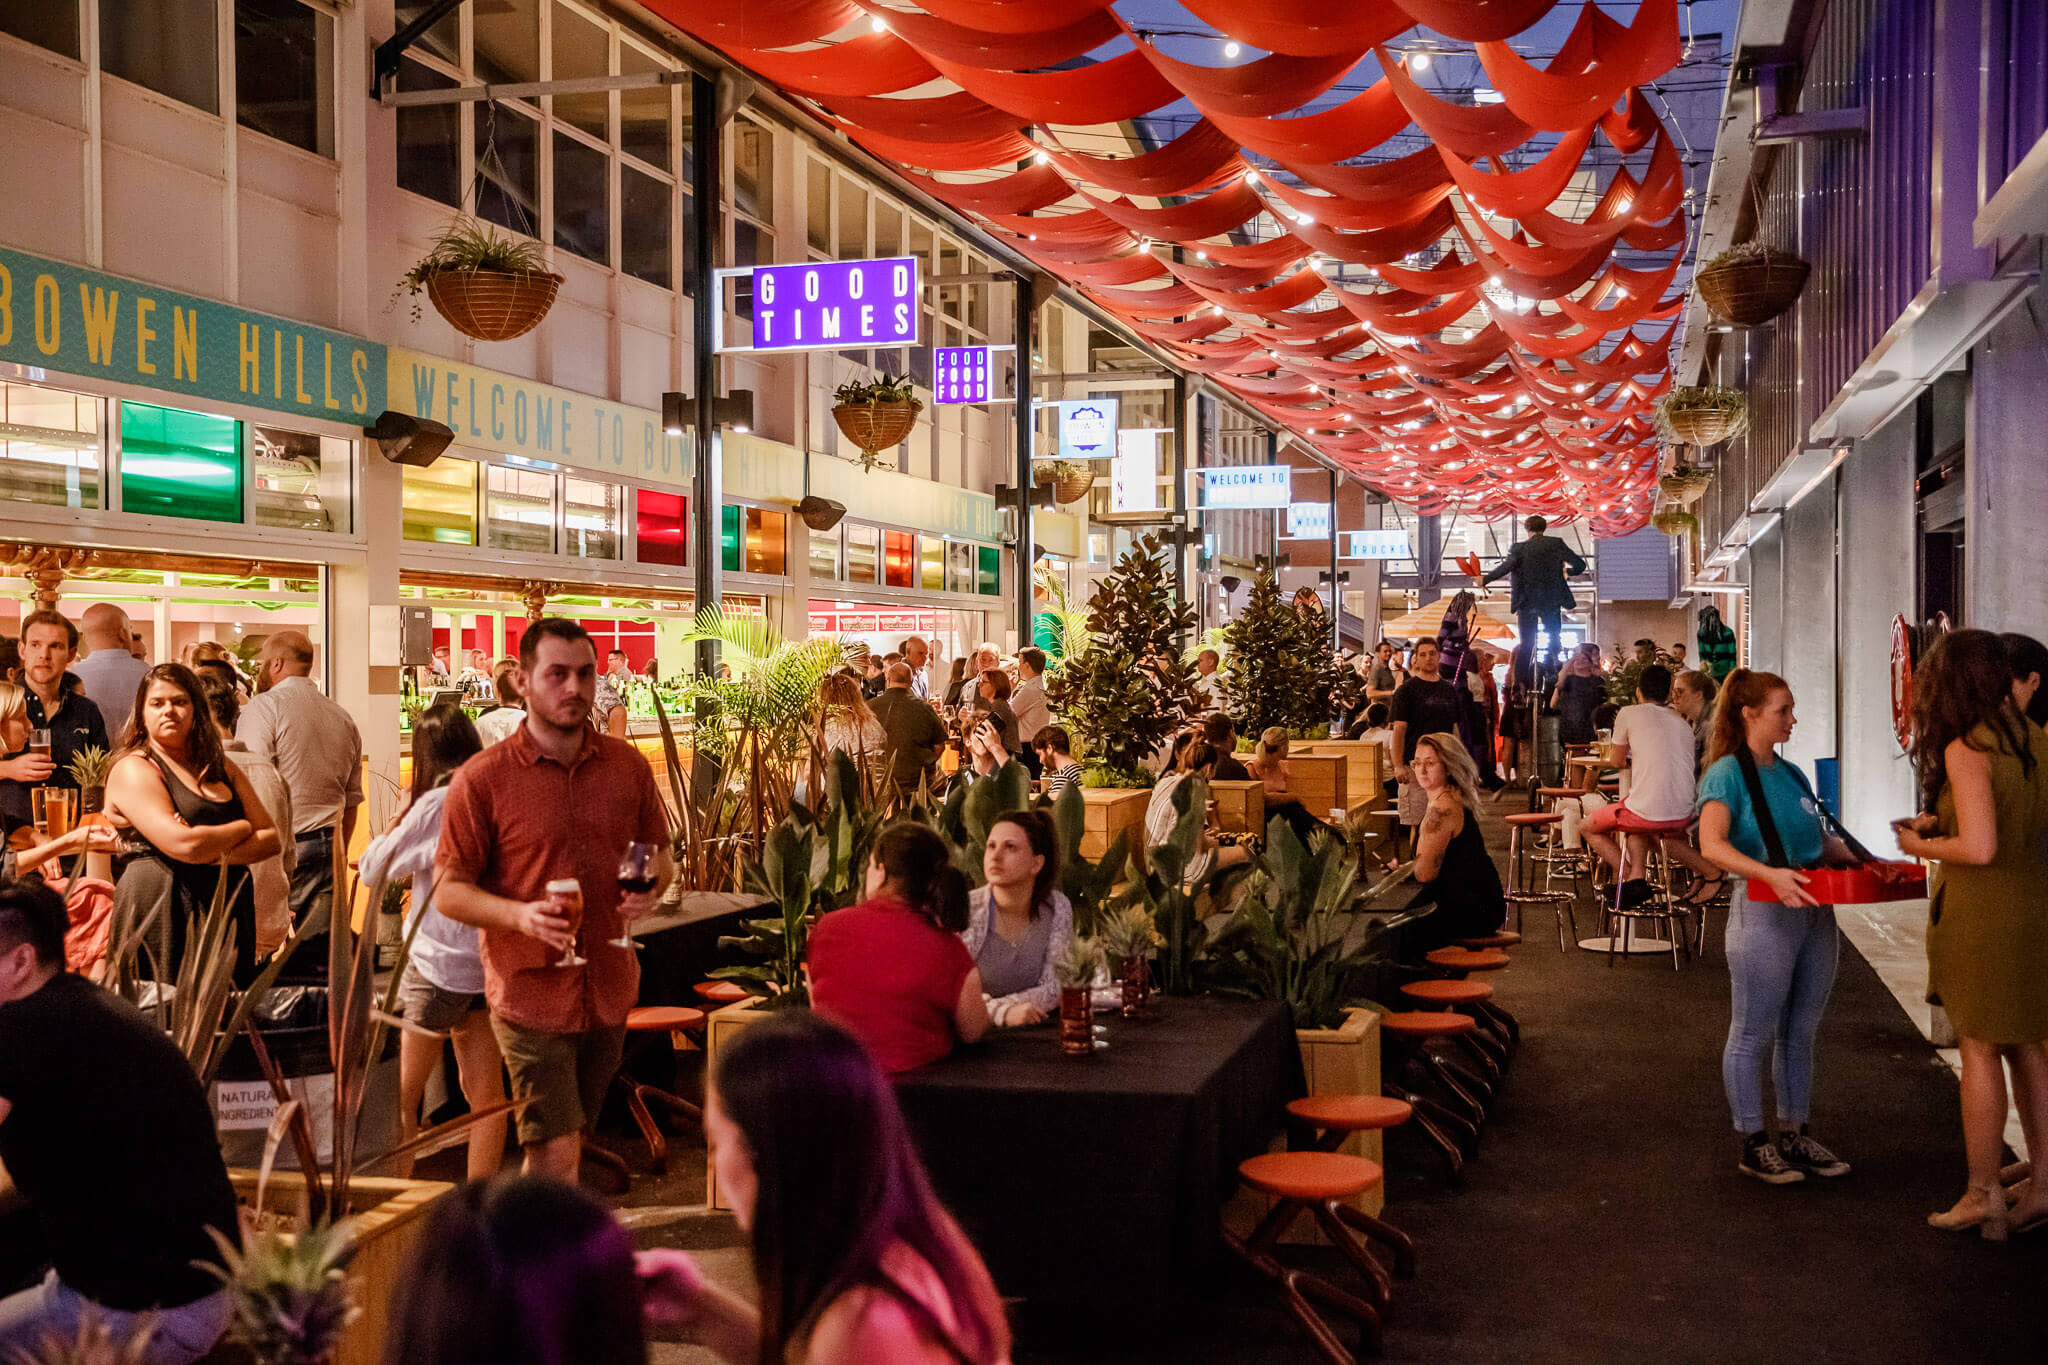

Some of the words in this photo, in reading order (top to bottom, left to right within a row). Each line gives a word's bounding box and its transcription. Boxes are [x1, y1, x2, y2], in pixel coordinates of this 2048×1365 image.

[761, 265, 908, 305] GOOD
[761, 303, 909, 342] TIMES
[240, 322, 367, 414] HILLS
[938, 350, 984, 367] FOOD
[938, 366, 984, 383] FOOD
[938, 383, 984, 399] FOOD
[413, 363, 571, 454] WELCOME
[594, 408, 623, 465] TO
[1210, 473, 1264, 486] WELCOME
[1272, 472, 1284, 483] TO
